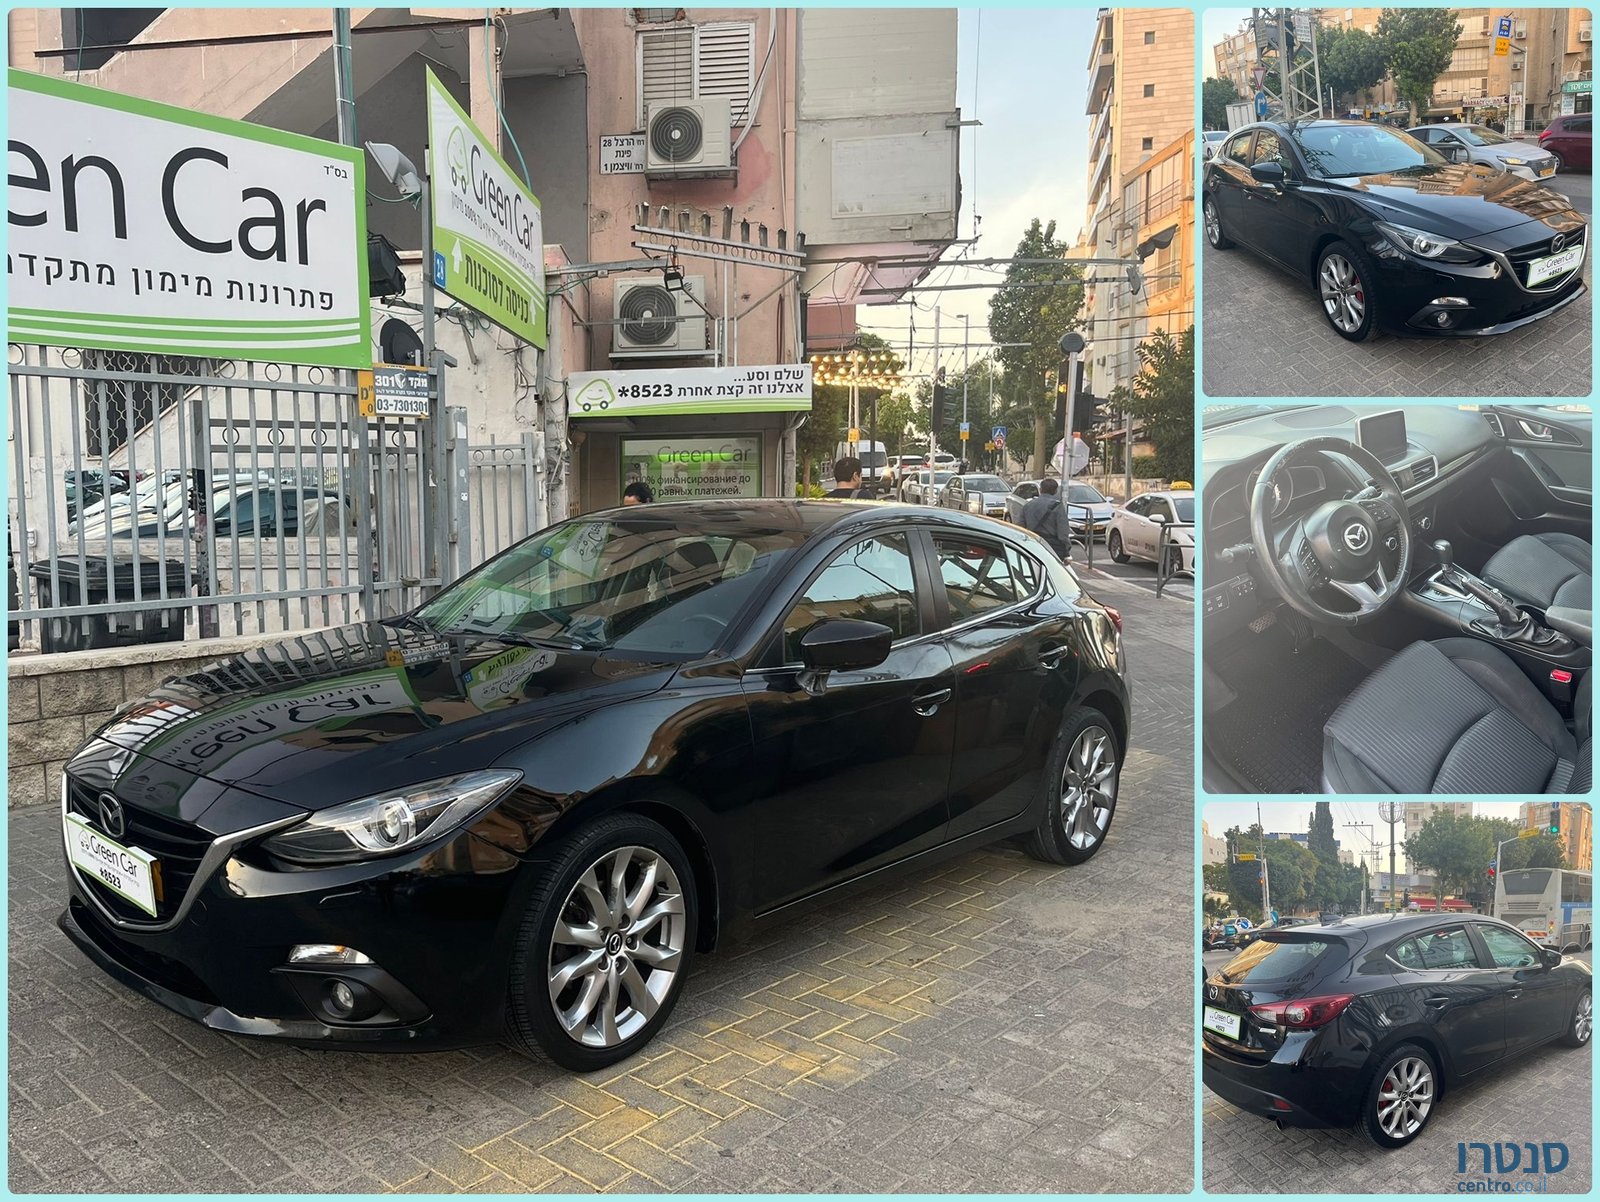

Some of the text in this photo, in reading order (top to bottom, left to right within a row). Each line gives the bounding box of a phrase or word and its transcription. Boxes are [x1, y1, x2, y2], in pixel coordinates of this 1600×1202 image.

[602, 139, 612, 147] 28
[613, 137, 635, 147] הרצל
[614, 149, 632, 158] פינת
[603, 163, 608, 171] 1
[470, 144, 513, 235] Green
[513, 193, 534, 253] Car
[161, 146, 327, 266] Car
[131, 267, 213, 297] מימון
[465, 253, 529, 324] כניסה לסוכנות
[226, 279, 334, 311] פתרונות
[374, 375, 395, 387] 301
[733, 369, 804, 382] שלם וסע...
[677, 386, 713, 397] אחרת
[717, 385, 744, 398] קצת
[748, 383, 763, 394] זה
[767, 382, 804, 394] אצלנו
[376, 398, 428, 413] 03-7301301
[657, 444, 752, 463] Green Car
[656, 474, 737, 487] финансирование
[738, 475, 751, 485] до
[658, 487, 693, 498] равных
[89, 835, 120, 868] Green
[119, 852, 138, 878] Car
